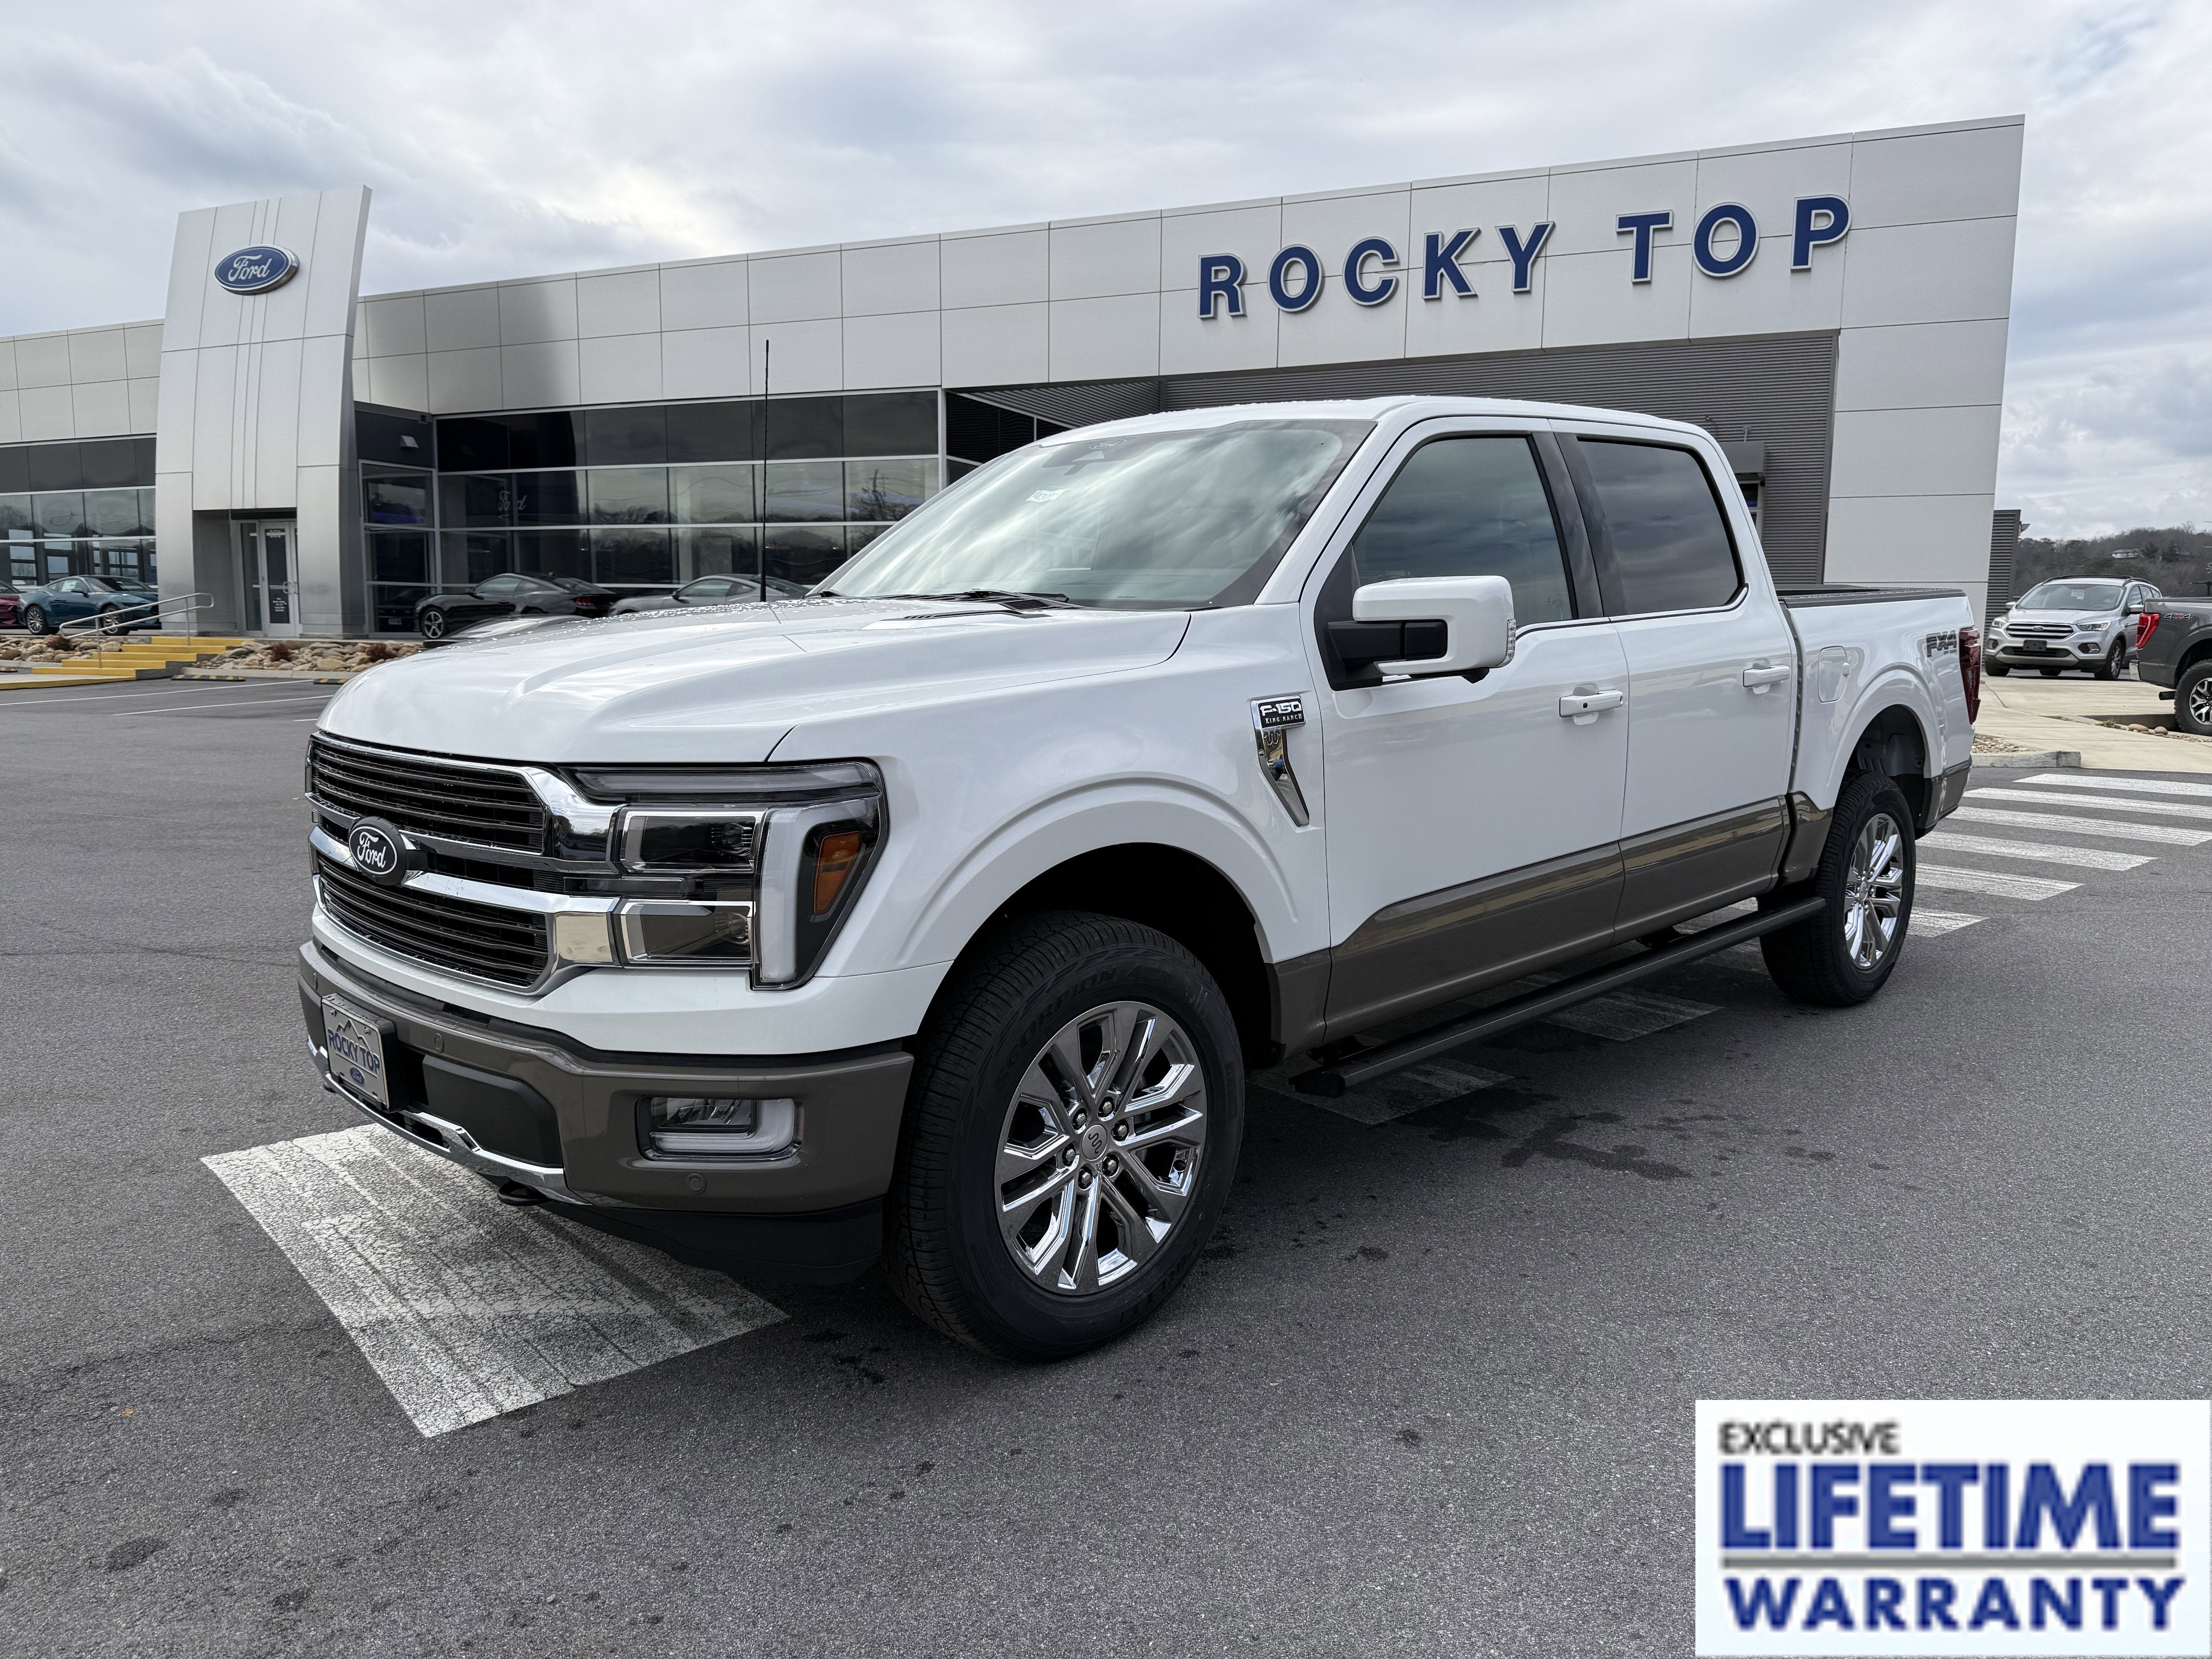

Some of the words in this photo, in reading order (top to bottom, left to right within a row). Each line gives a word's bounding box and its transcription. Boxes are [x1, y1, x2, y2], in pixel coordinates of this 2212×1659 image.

[228, 254, 272, 282] Ford
[1197, 222, 1555, 318] ROCKY
[1616, 194, 1852, 283] TOP
[498, 490, 527, 511] Fod
[1926, 630, 1957, 658] FX4
[1260, 701, 1302, 716] F-150
[1283, 713, 1302, 721] RANCH
[357, 831, 386, 868] Ford
[993, 967, 1118, 1092] SCORPION
[328, 1028, 359, 1062] ROCKY
[359, 1045, 380, 1073] TOP
